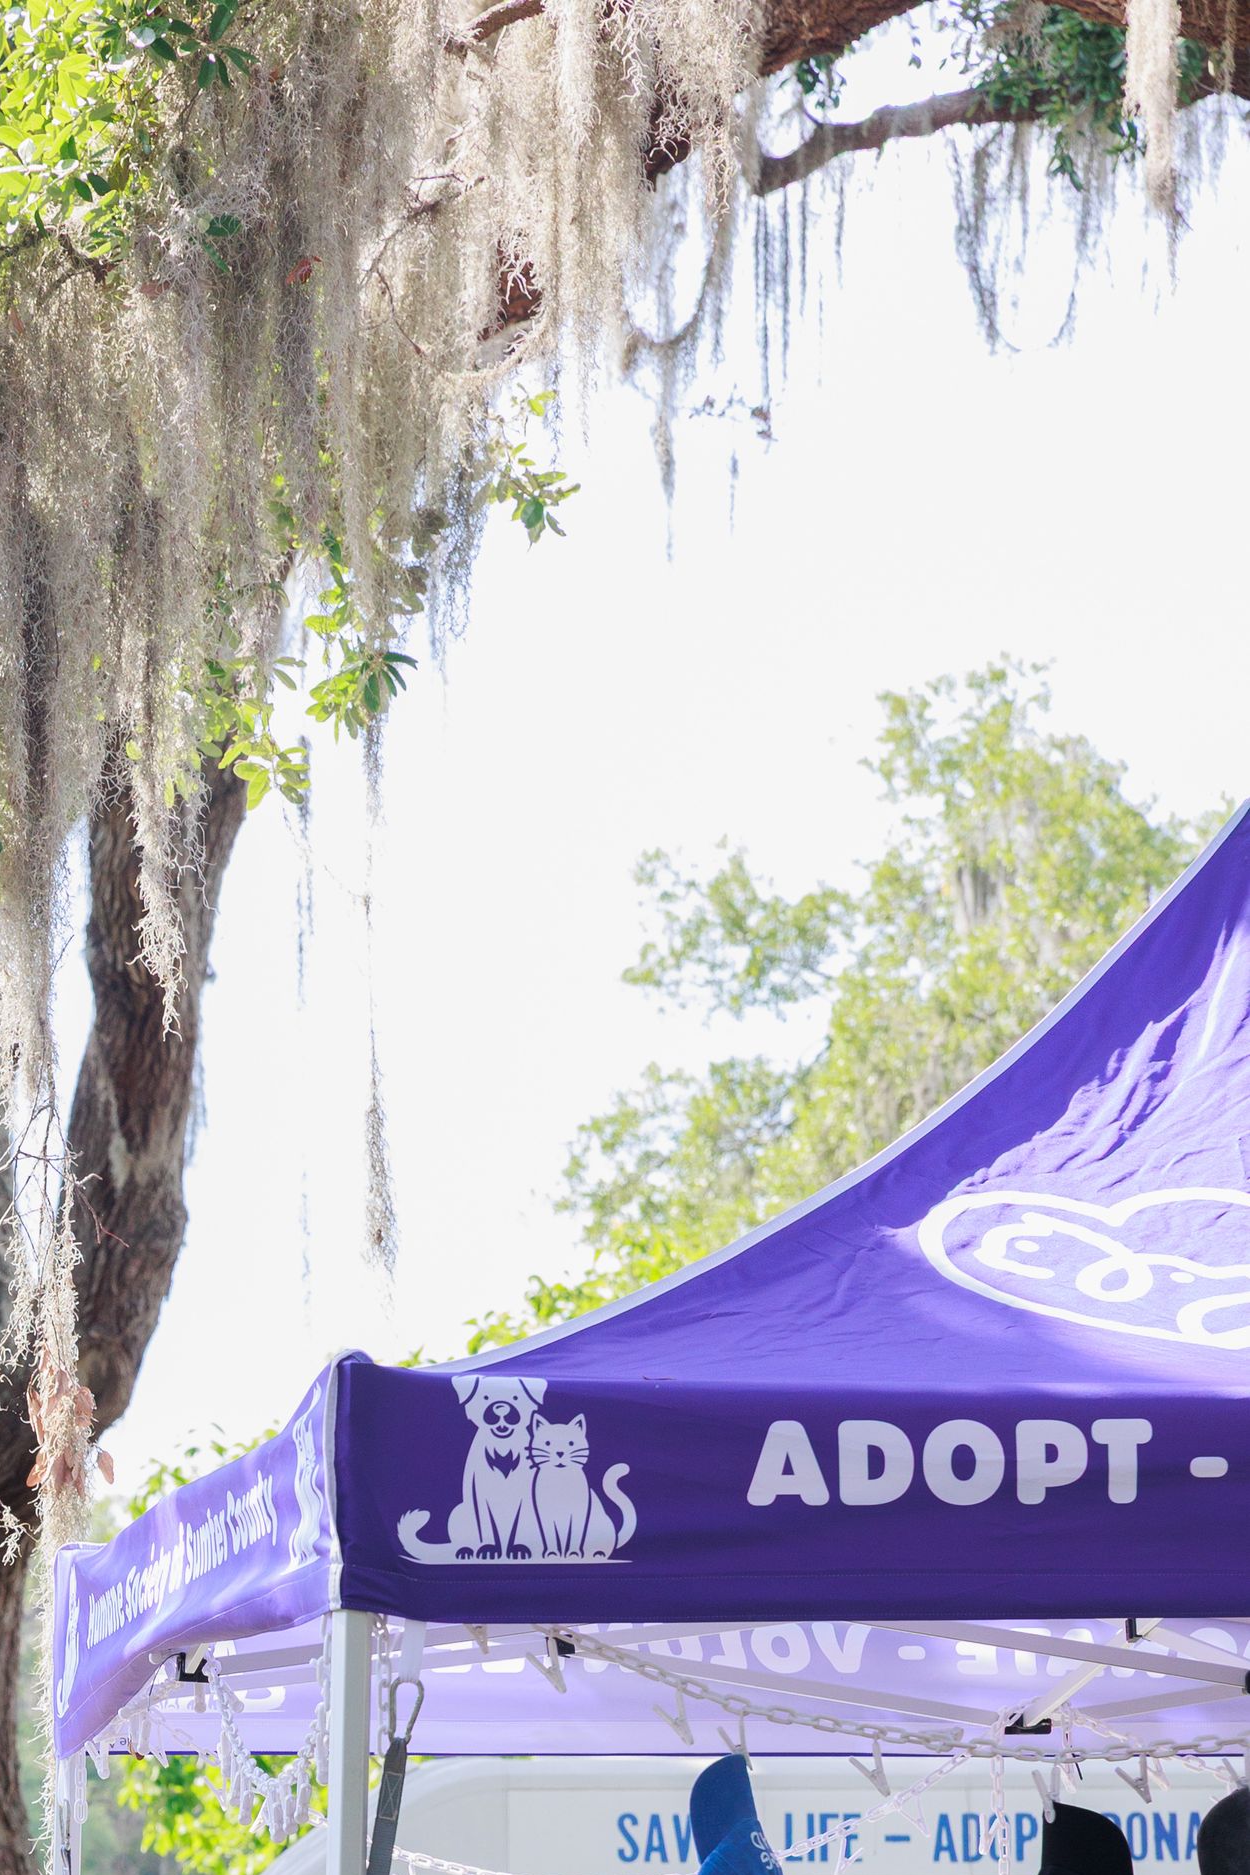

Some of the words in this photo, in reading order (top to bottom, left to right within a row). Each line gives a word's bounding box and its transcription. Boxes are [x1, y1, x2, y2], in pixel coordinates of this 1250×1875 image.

[747, 1419, 1153, 1506] ADOPT
[87, 1582, 126, 1649] Humane
[125, 1542, 172, 1622] Society
[184, 1507, 228, 1584] Sumter
[226, 1469, 278, 1556] County
[617, 1813, 692, 1863] SAV
[933, 1812, 1039, 1863] ADOP
